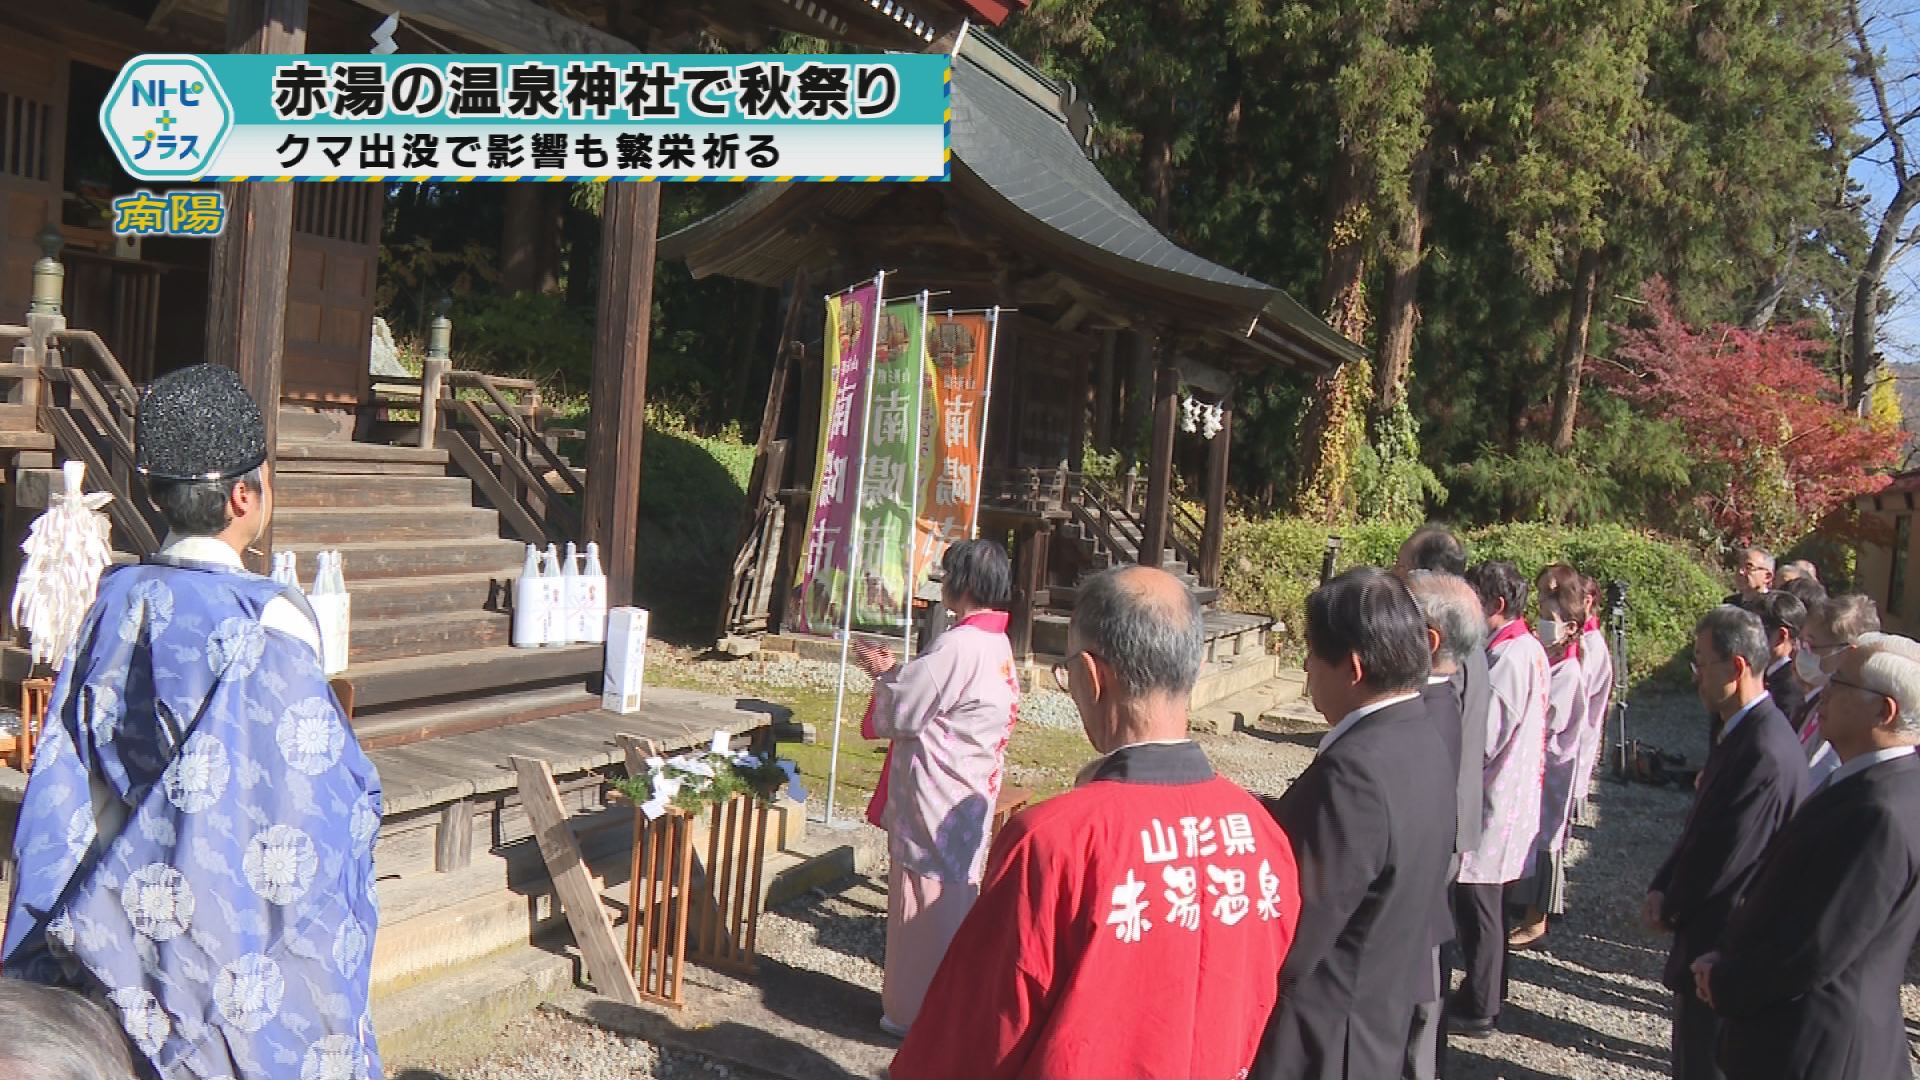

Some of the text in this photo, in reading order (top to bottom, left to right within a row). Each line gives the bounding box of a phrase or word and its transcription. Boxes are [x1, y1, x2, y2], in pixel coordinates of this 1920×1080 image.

[1140, 812, 1257, 864] 山形県
[1106, 858, 1282, 944] 赤湯温泉
